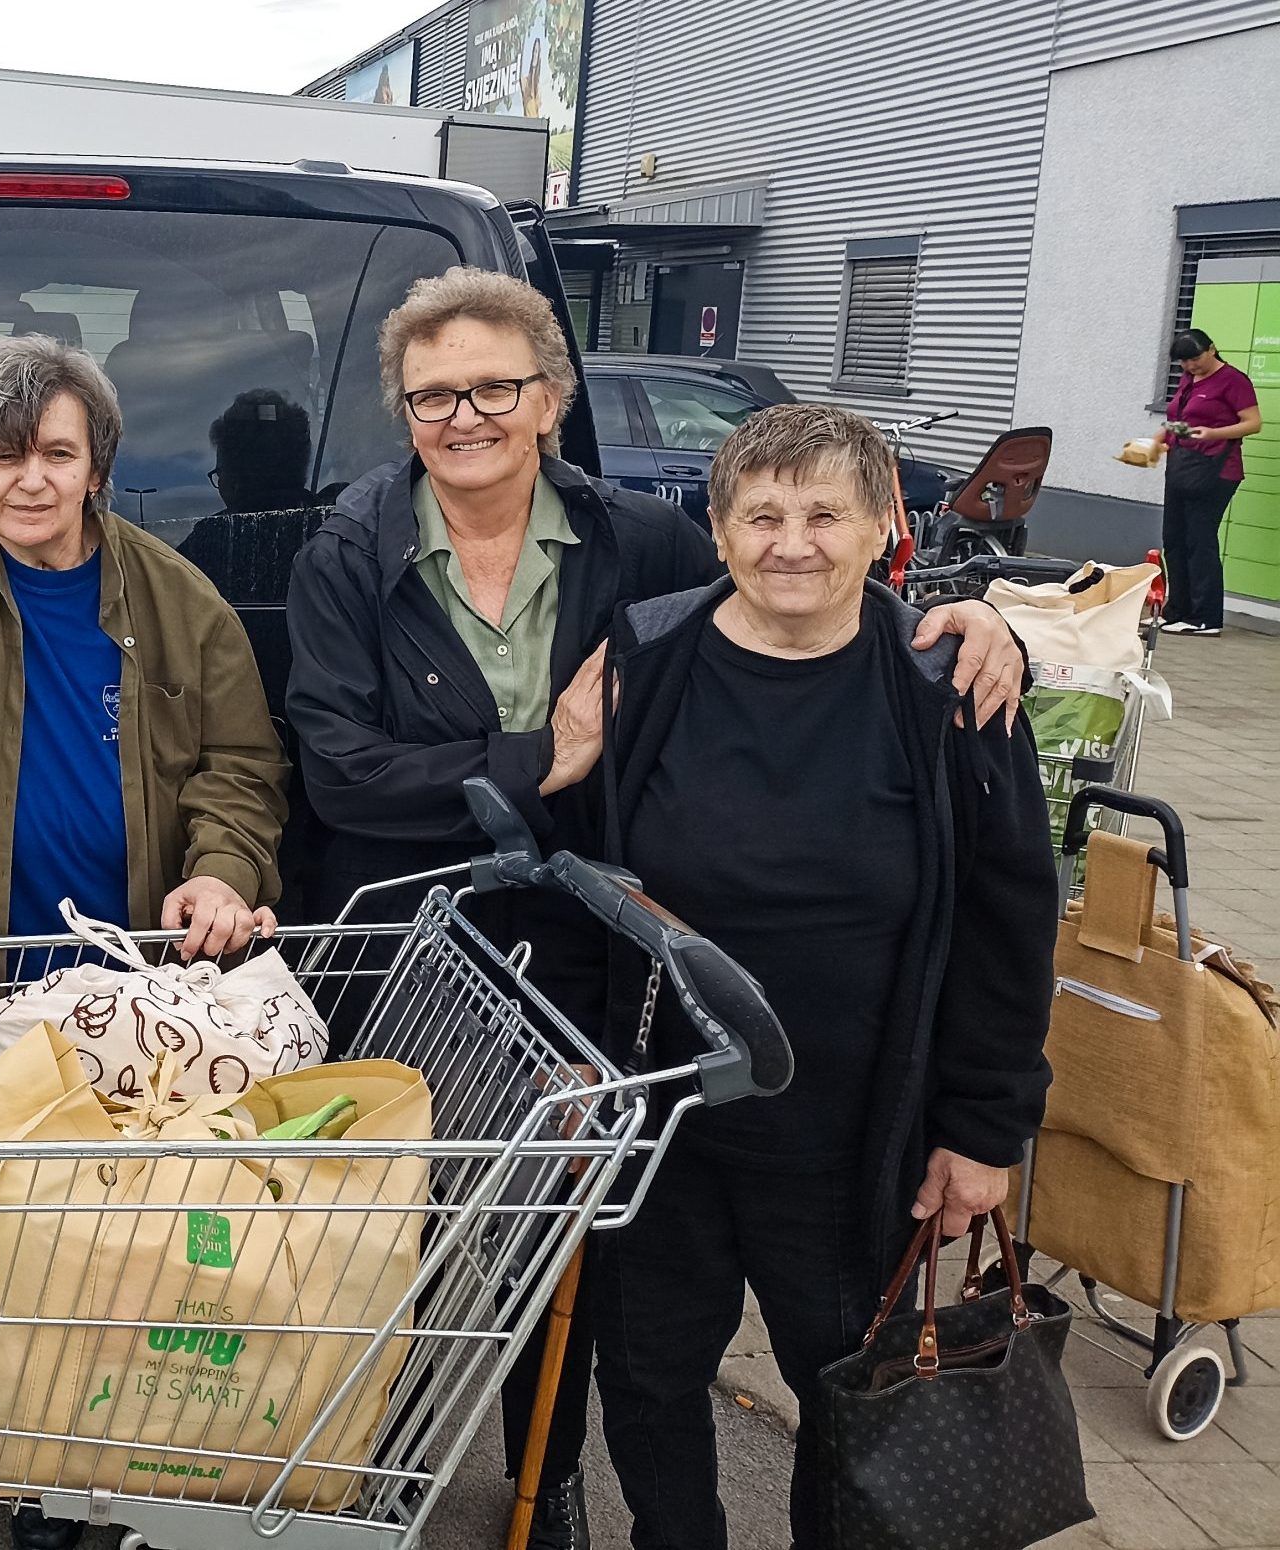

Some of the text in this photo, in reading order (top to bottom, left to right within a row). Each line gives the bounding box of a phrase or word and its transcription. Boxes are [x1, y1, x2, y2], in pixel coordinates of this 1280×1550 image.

[464, 53, 521, 110] SVJEŽINE!
[174, 1299, 234, 1322] THATS
[136, 1375, 245, 1409] IS SMART
